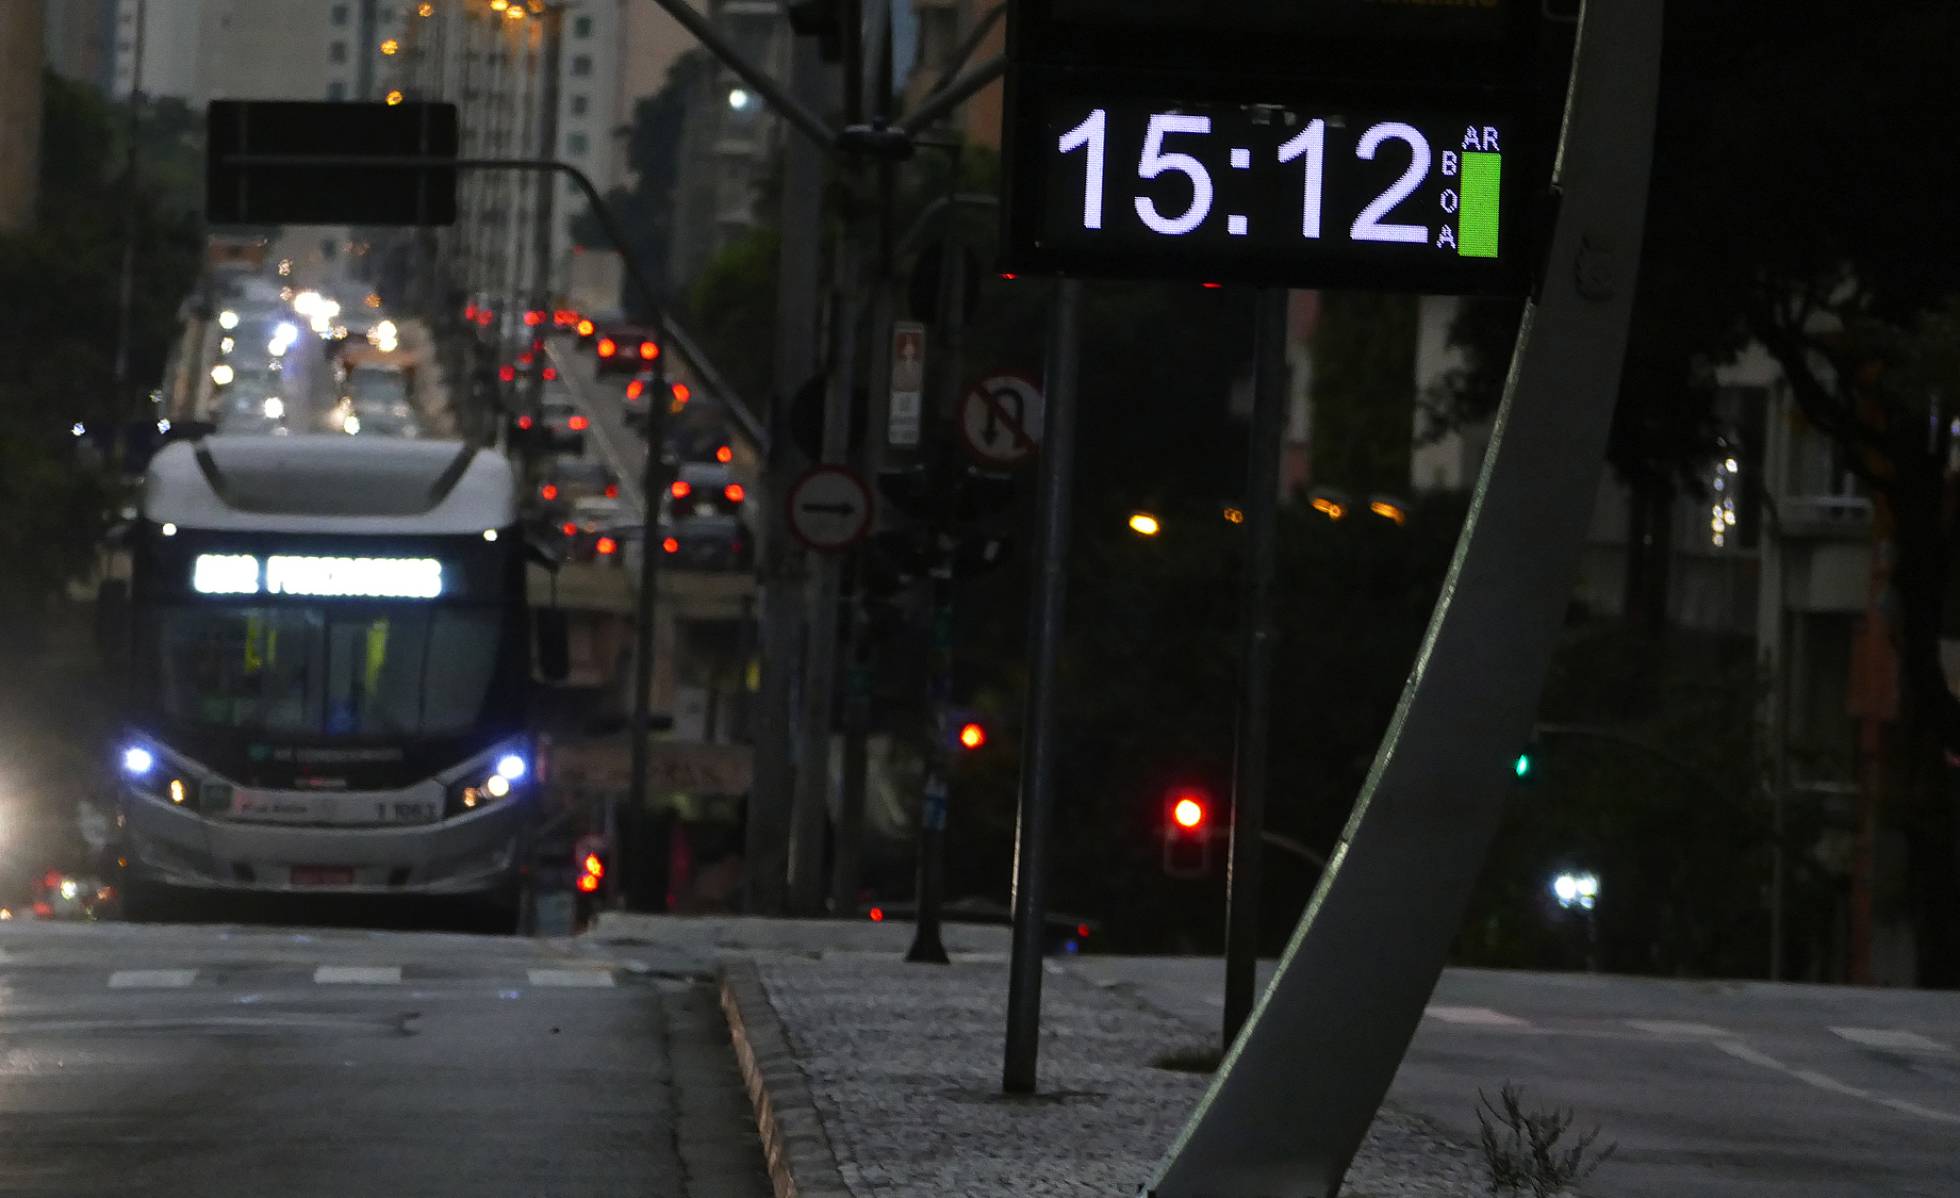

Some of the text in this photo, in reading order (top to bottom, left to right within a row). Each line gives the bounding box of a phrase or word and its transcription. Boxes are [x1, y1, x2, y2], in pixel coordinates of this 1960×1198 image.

[1058, 108, 1432, 244] 15:12
[1461, 125, 1501, 151] AR
[1435, 150, 1459, 249] BOA
